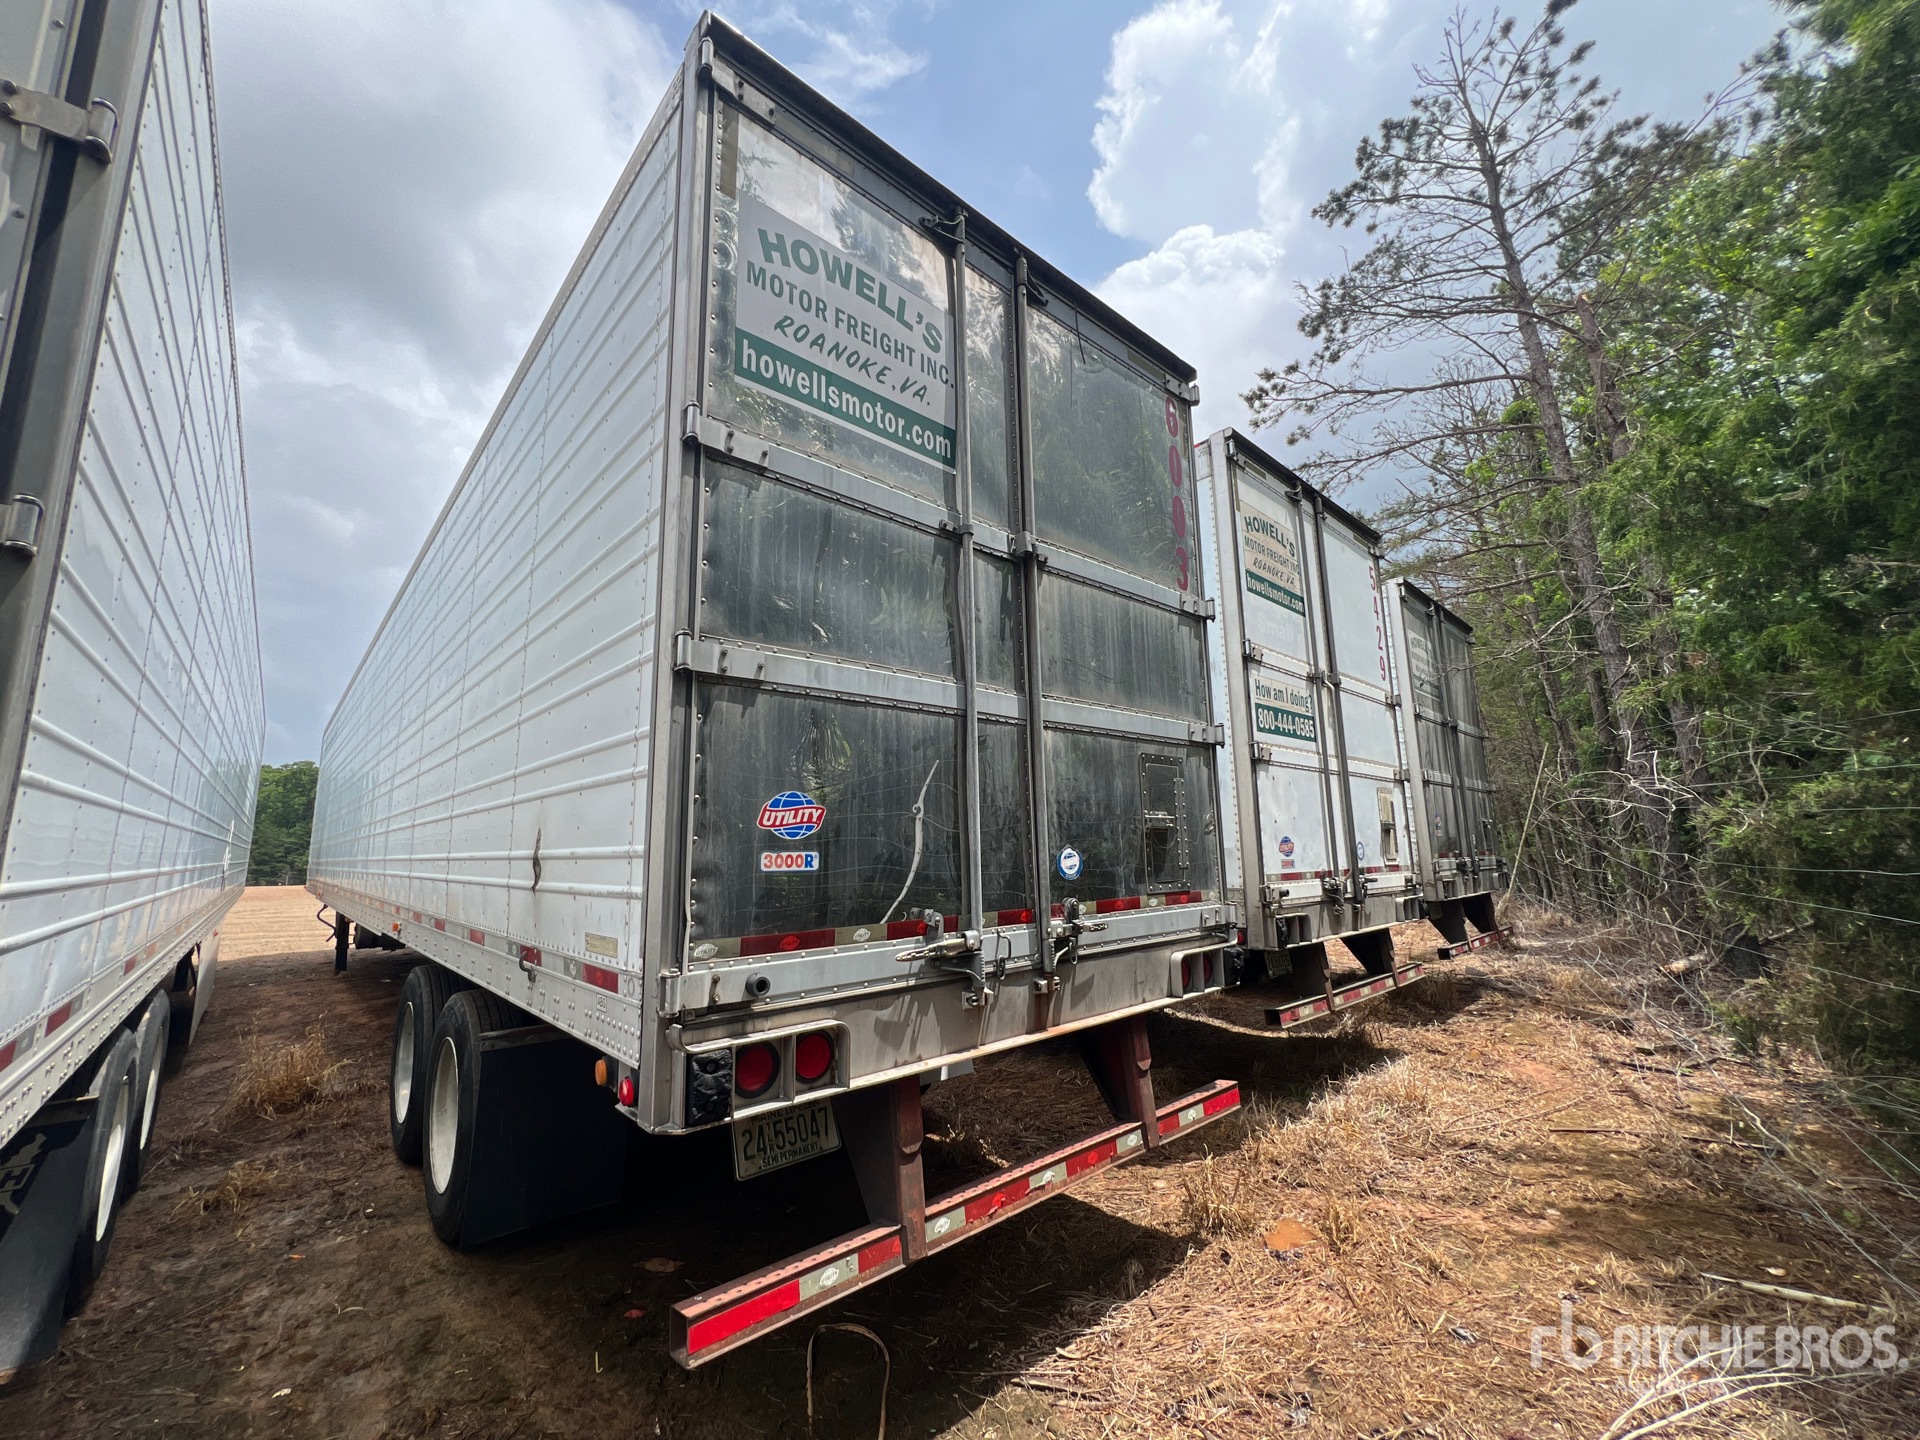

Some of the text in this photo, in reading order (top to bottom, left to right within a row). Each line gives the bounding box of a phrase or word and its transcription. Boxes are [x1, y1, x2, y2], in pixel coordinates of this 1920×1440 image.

[757, 228, 943, 353] HOWELL'S
[746, 260, 955, 389] MOTOR FREIGHT INC.
[774, 315, 931, 406] ROANOKE, VA.
[742, 338, 951, 459] howellsmotor.com
[1244, 516, 1295, 558] HOWELL'S
[1244, 535, 1267, 556] MOTOR
[1266, 547, 1290, 570] FREIGHT
[1247, 573, 1304, 612] howellsmotor.com
[1369, 566, 1386, 681] 5429
[1255, 678, 1271, 699] How
[1273, 688, 1285, 703] am
[1289, 692, 1313, 713] doing?
[1258, 708, 1315, 738] 800-444-0585
[762, 808, 822, 826] UTILITY
[763, 853, 815, 869] 3000R
